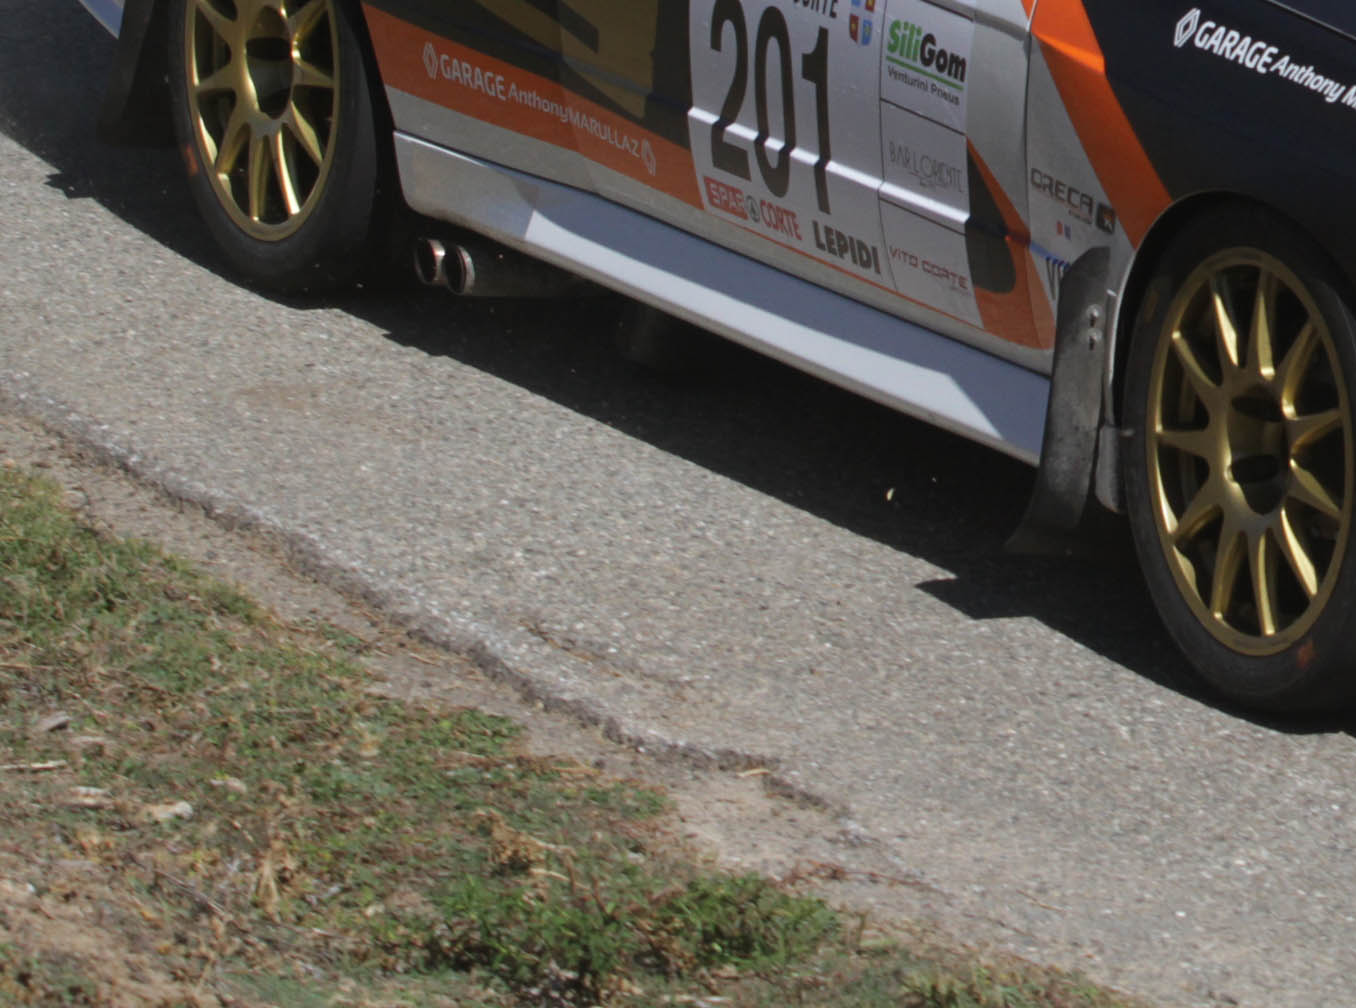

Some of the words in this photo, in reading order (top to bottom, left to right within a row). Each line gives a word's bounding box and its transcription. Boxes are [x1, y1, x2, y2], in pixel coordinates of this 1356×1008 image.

[1194, 20, 1279, 75] GARAGE
[1270, 55, 1346, 103] Anthony
[440, 54, 506, 102] GARAGE
[506, 83, 570, 123] Anthony
[568, 108, 641, 158] MARULLAZ
[760, 199, 802, 241] CORTE
[812, 219, 881, 275] LEPIDI
